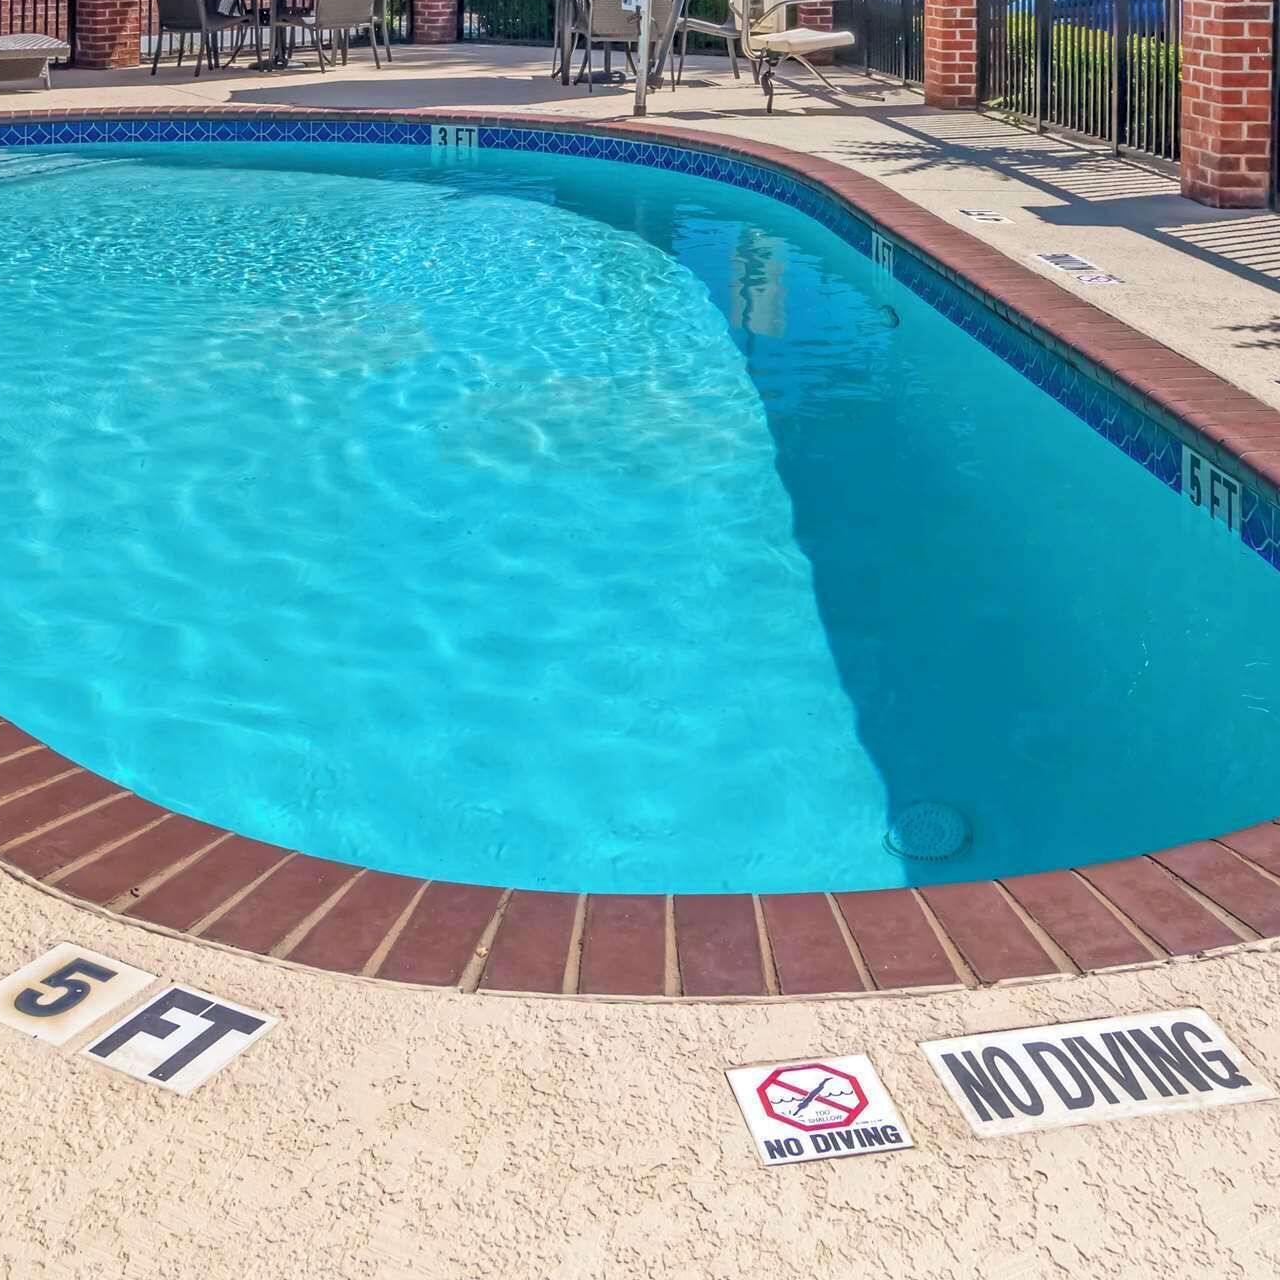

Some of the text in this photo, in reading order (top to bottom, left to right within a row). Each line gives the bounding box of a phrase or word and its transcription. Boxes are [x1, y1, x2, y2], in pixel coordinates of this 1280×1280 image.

[438, 127, 476, 148] 3 FT
[1189, 453, 1238, 532] 5 FT
[14, 957, 267, 1082] 5 FT
[941, 1021, 1253, 1122] NO DIVING
[764, 1125, 904, 1159] NO DIVING
[808, 1114, 843, 1124] SHALLOW
